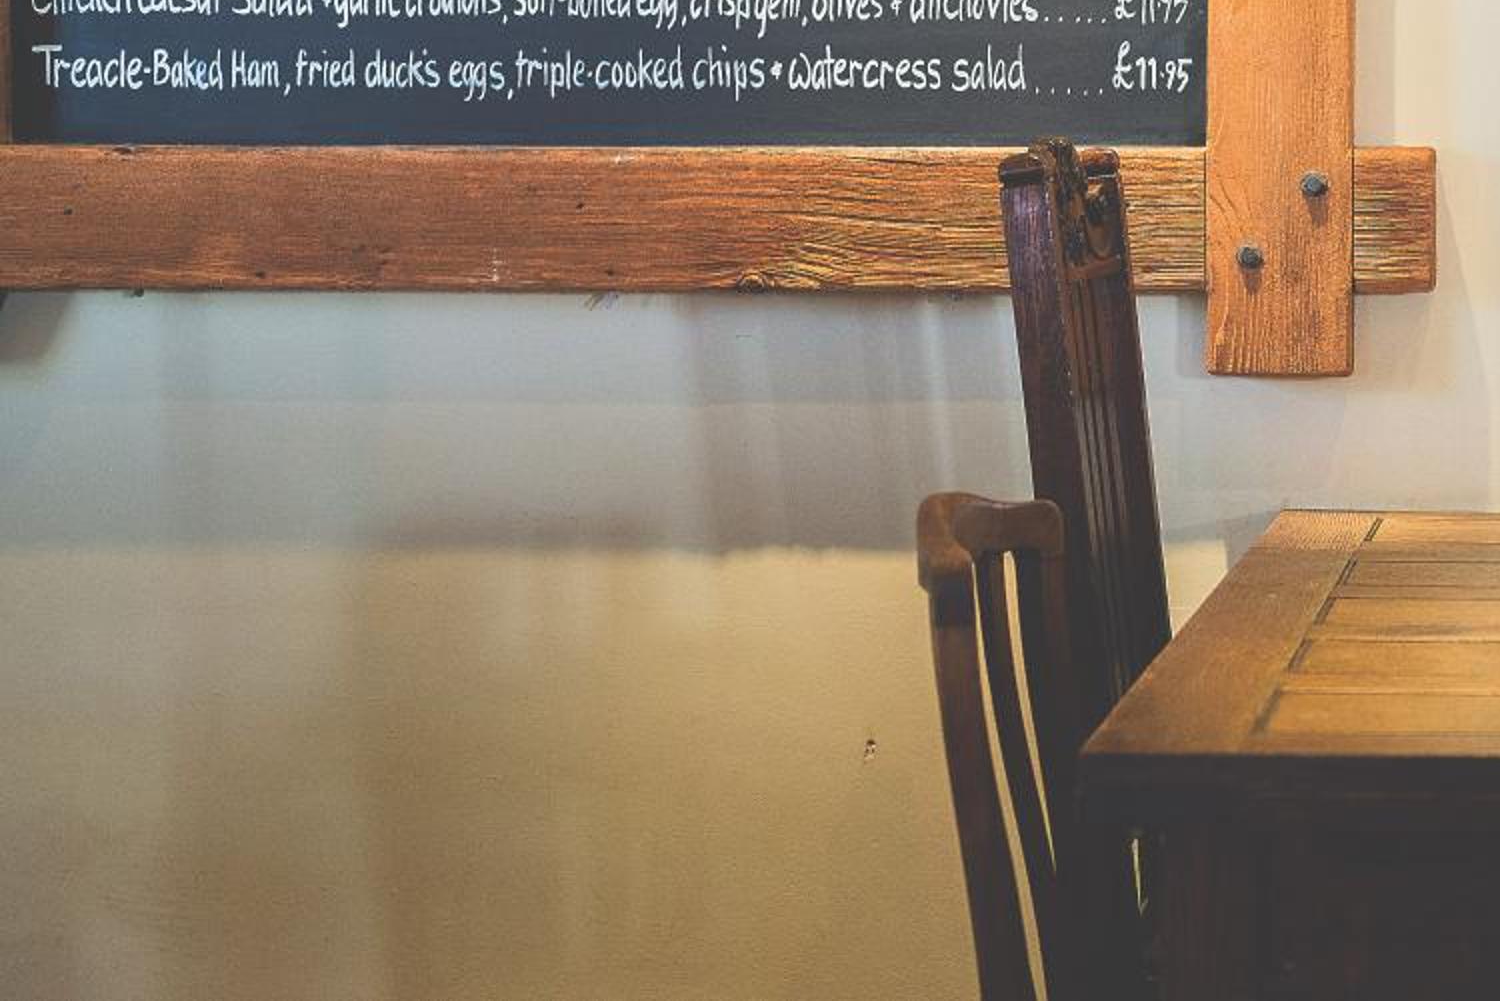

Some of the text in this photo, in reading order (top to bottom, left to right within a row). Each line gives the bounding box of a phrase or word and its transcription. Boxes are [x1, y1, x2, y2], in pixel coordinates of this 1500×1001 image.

[31, 44, 224, 91] Treacle-Baked
[295, 47, 356, 88] fried
[514, 45, 685, 99] triple-cooked
[692, 44, 766, 103] chips
[787, 44, 942, 91] watercress
[951, 43, 1027, 92] salad
